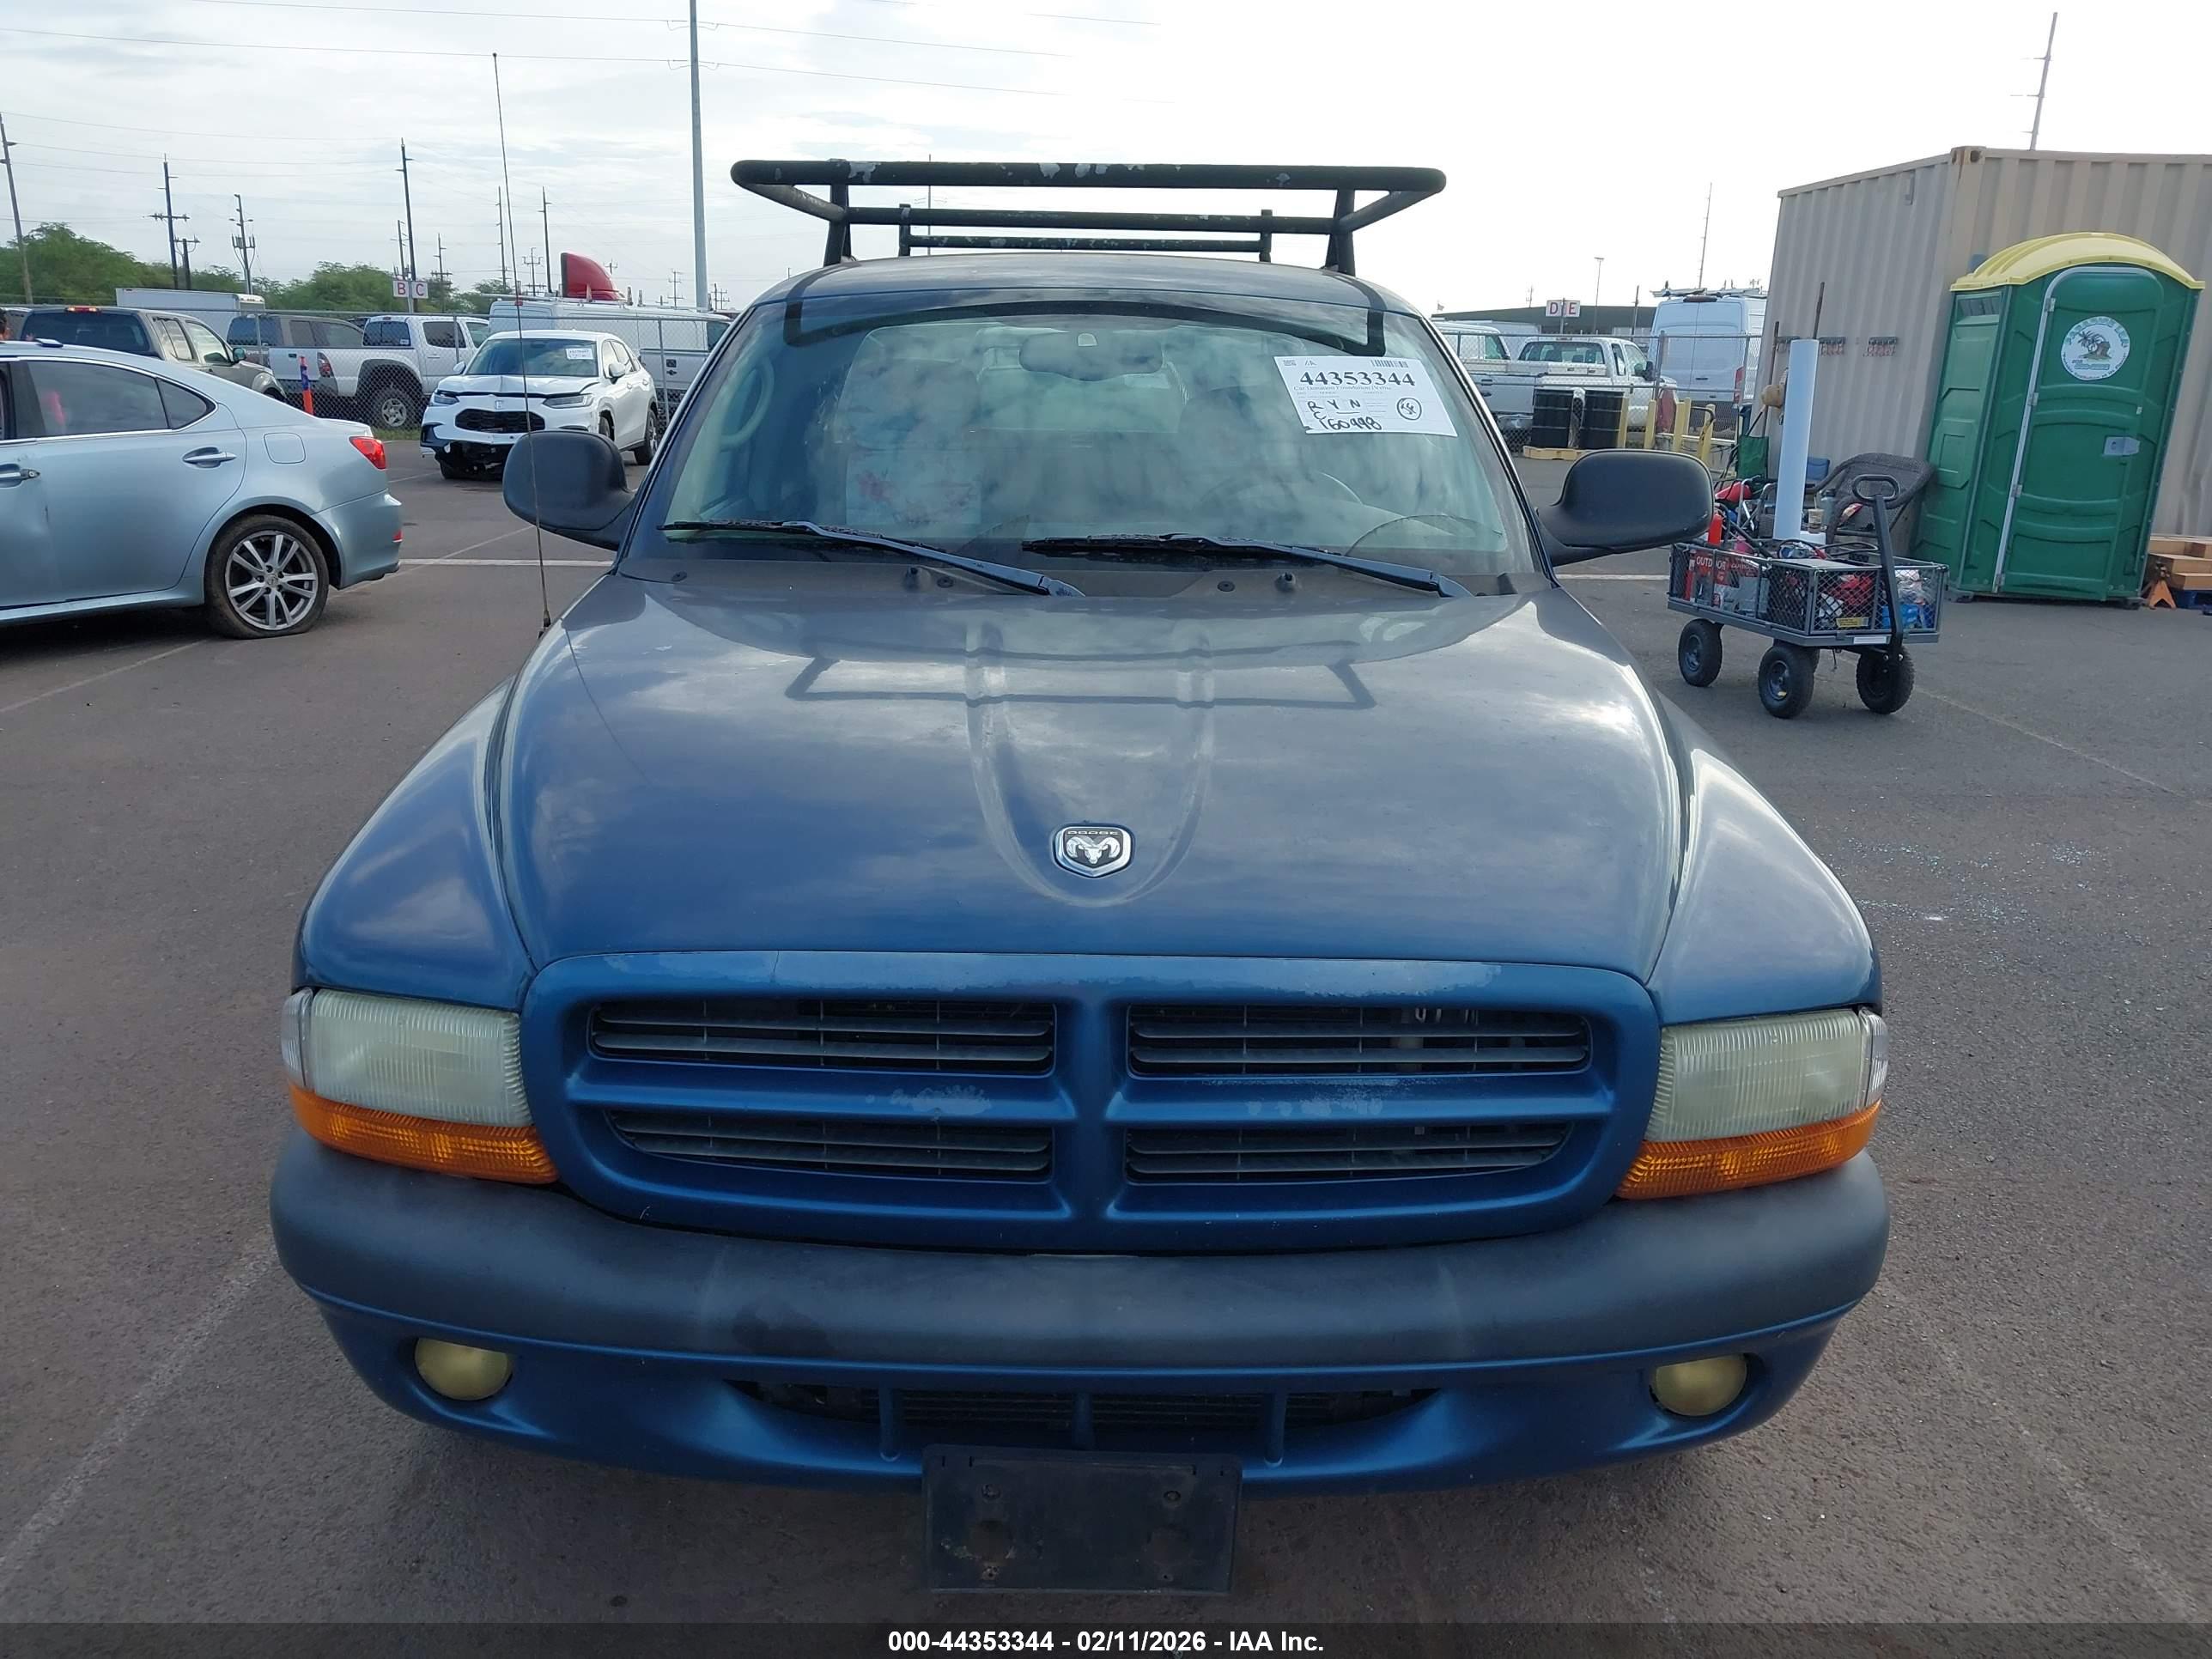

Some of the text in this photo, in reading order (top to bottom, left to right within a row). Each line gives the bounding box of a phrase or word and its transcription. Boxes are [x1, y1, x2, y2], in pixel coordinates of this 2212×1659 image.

[397, 282, 406, 295] B
[416, 283, 424, 296] C
[1549, 301, 1559, 314] D
[1568, 301, 1577, 314] E
[1299, 371, 1415, 387] 44353344
[1307, 398, 1361, 413] R Y N
[1696, 556, 1726, 570] OUTDOR
